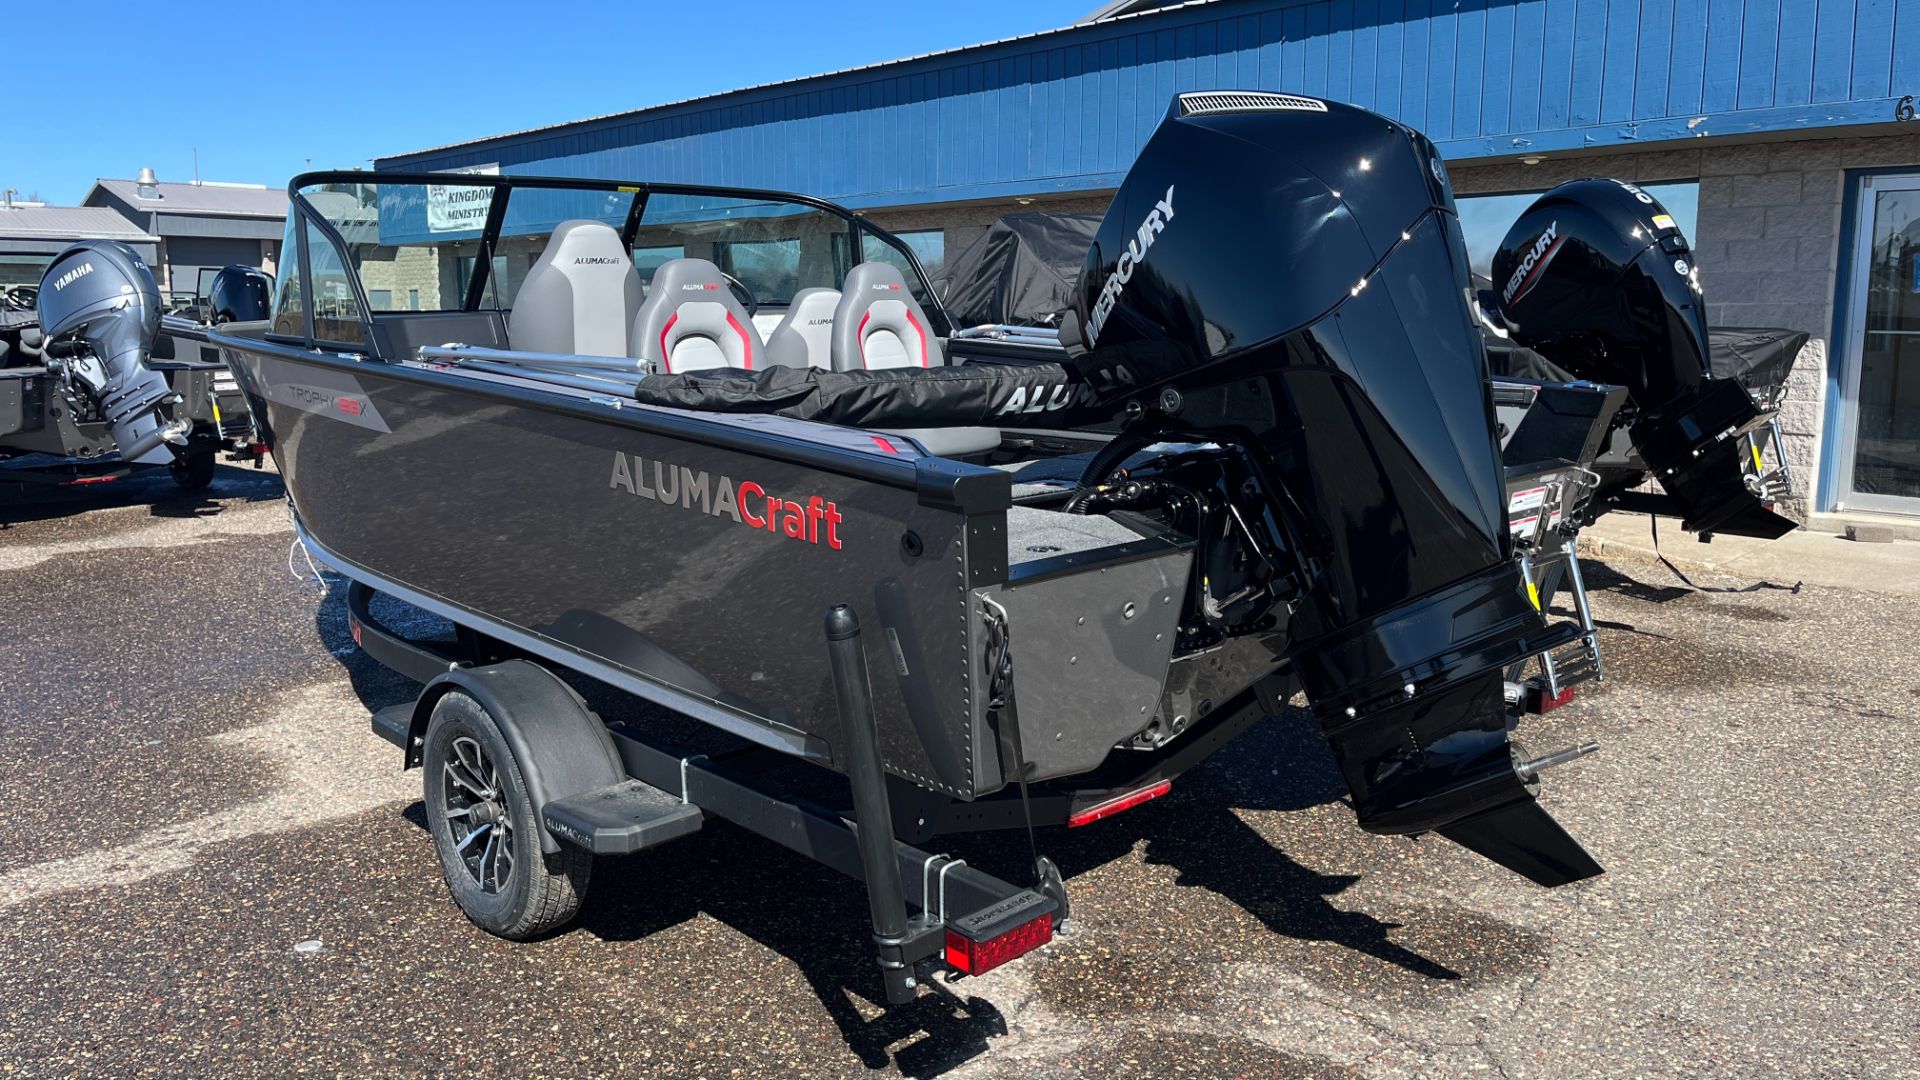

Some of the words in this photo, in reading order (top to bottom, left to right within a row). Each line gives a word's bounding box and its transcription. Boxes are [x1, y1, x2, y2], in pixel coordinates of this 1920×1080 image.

[448, 187, 495, 204] KINGDOM
[54, 262, 94, 292] YAMAHA
[1085, 184, 1175, 349] MERCURY
[1503, 219, 1557, 304] MERCURY
[288, 385, 335, 409] TROPHY
[609, 451, 843, 551] ALUMACraft
